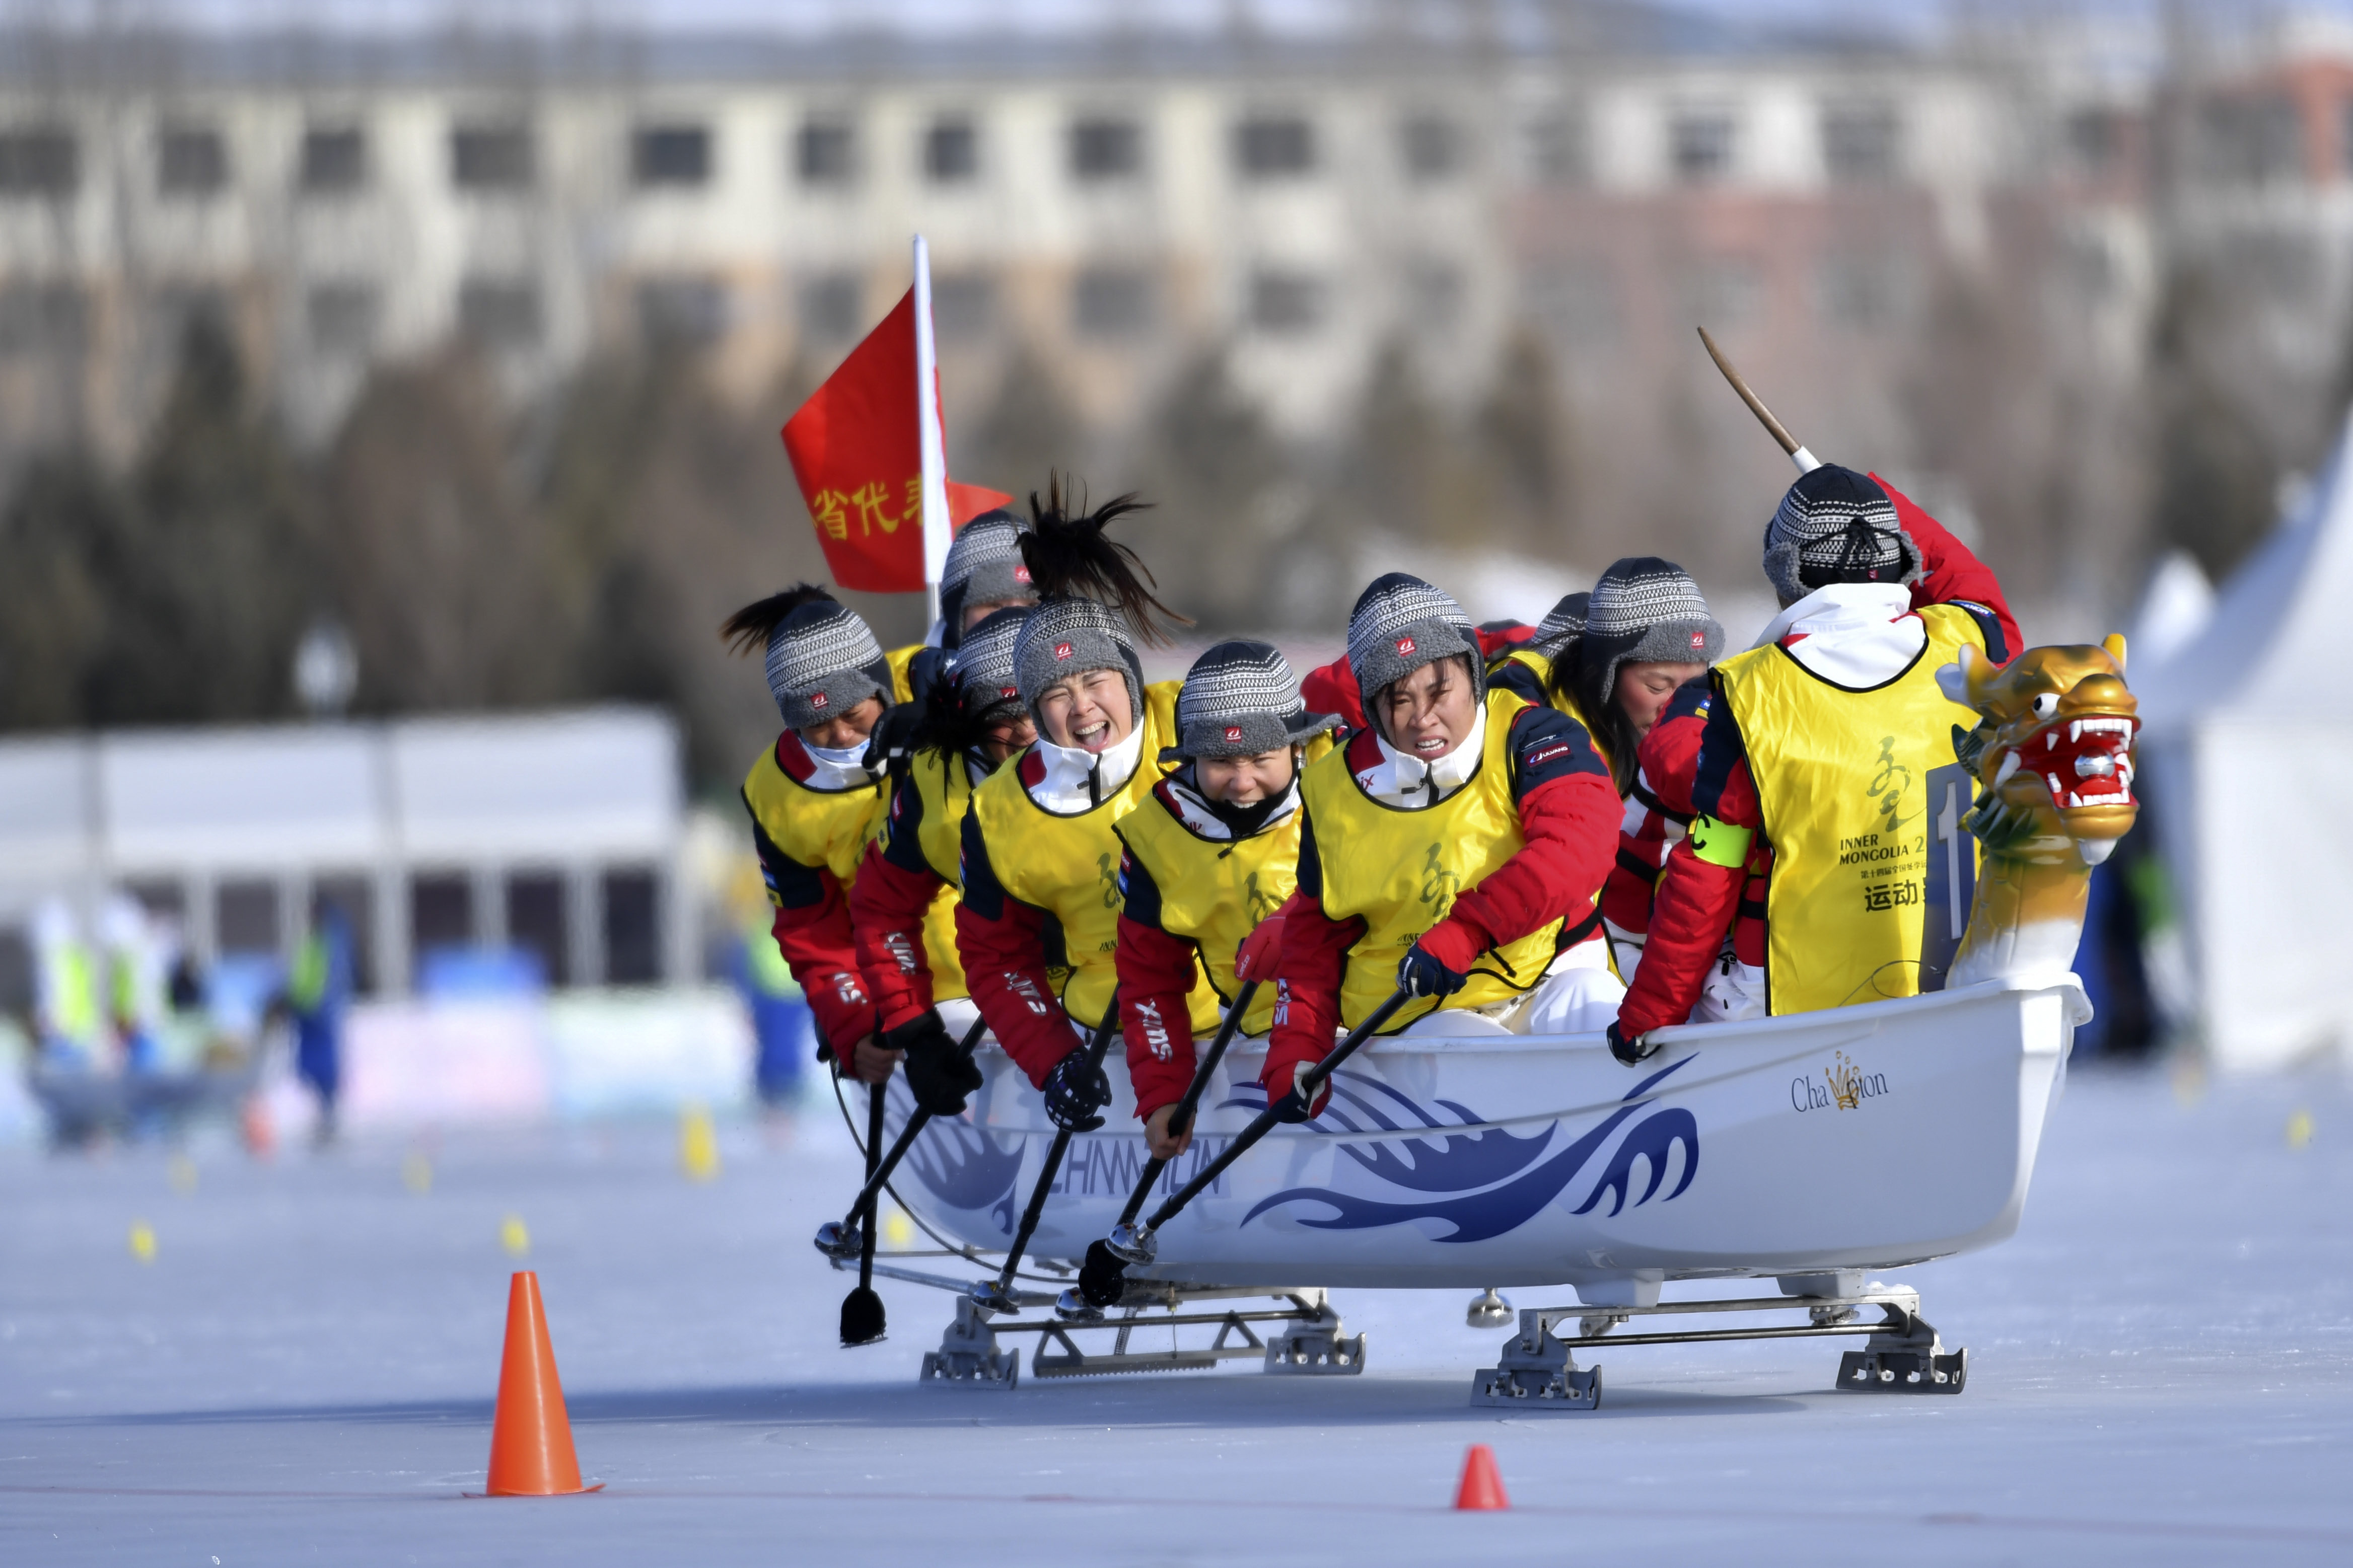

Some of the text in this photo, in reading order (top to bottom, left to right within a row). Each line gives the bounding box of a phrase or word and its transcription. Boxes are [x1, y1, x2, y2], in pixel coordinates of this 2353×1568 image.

[813, 474, 922, 540] 省代表
[1839, 845, 1909, 865] MONGOLIA
[1840, 834, 1878, 851] INNER
[1937, 781, 1962, 940] 1
[1864, 877, 1926, 913] 运动
